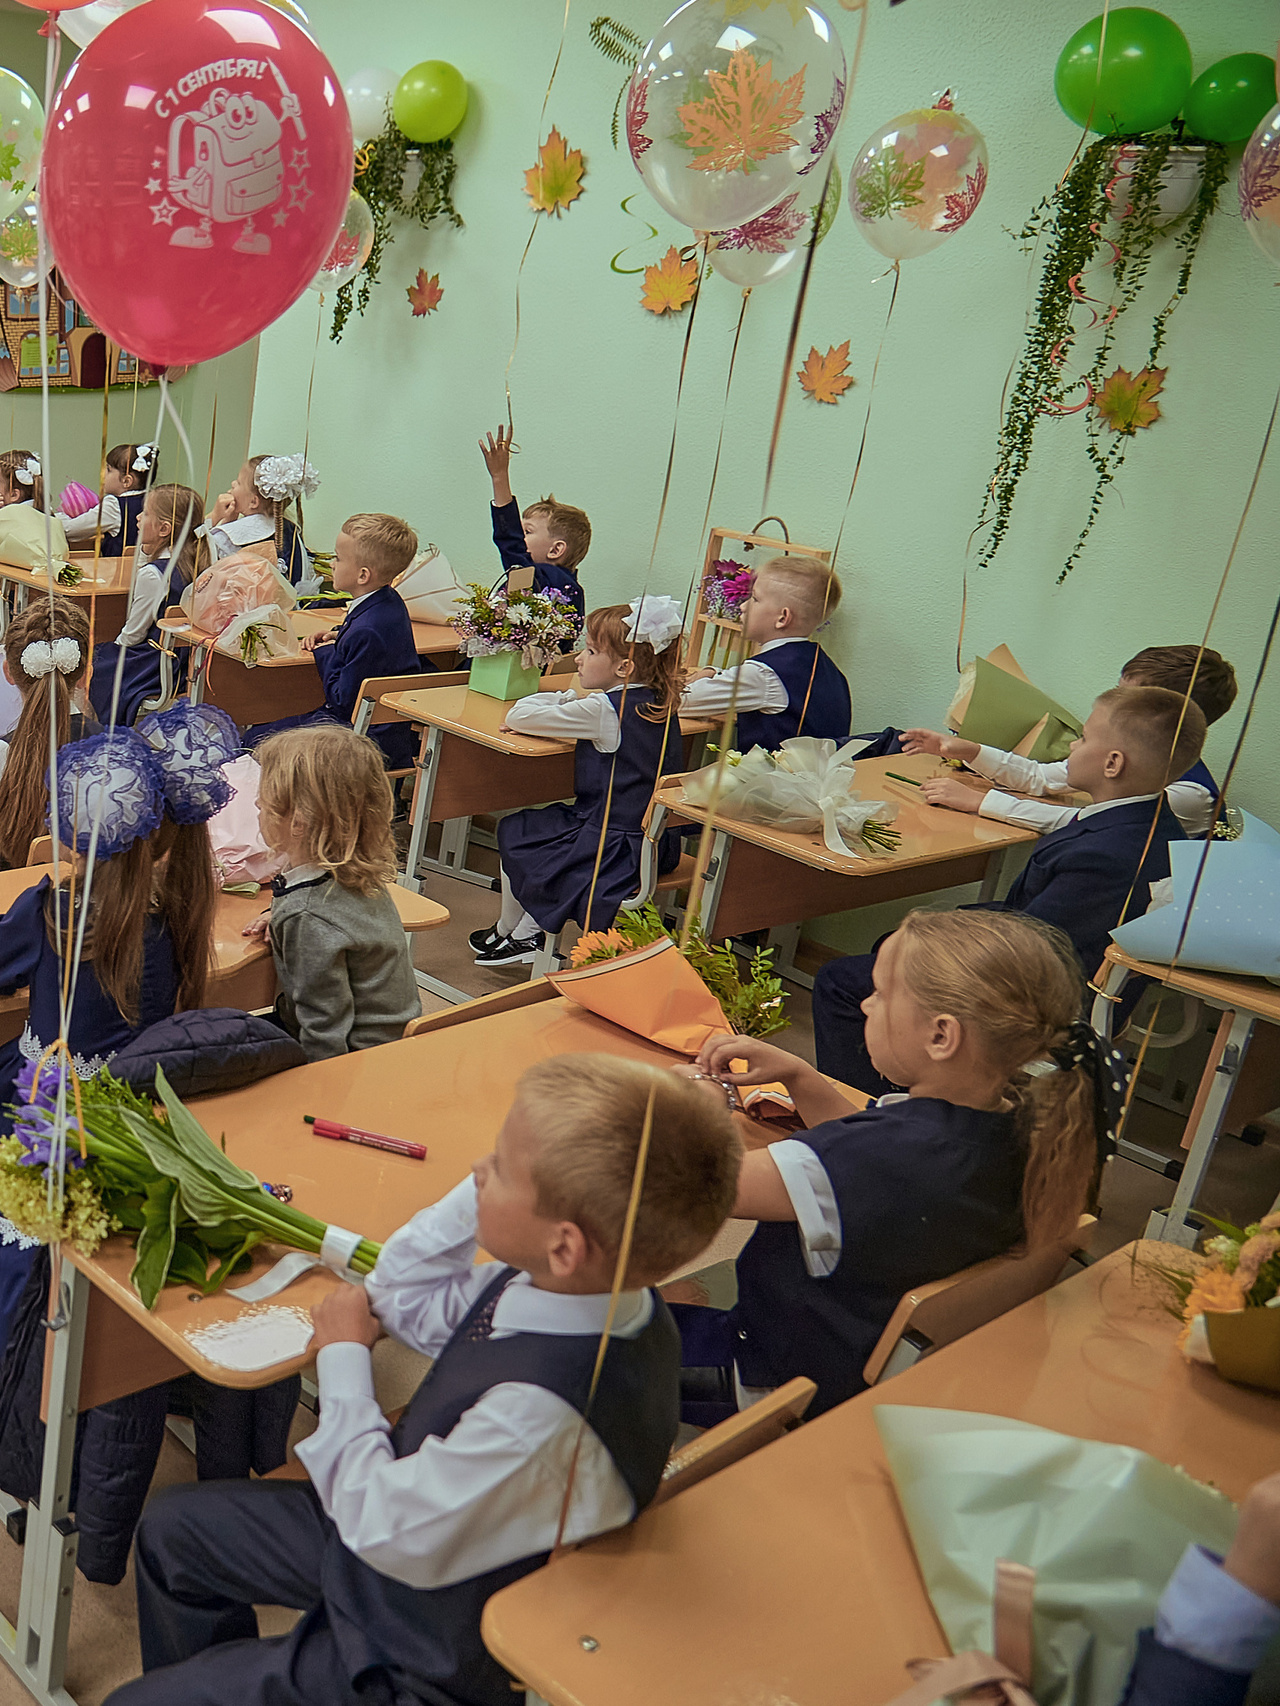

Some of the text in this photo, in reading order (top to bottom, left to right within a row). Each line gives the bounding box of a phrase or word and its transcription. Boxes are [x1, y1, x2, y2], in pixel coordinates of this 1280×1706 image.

[155, 58, 268, 118] С 1 СЕНТЯБРЯ!
